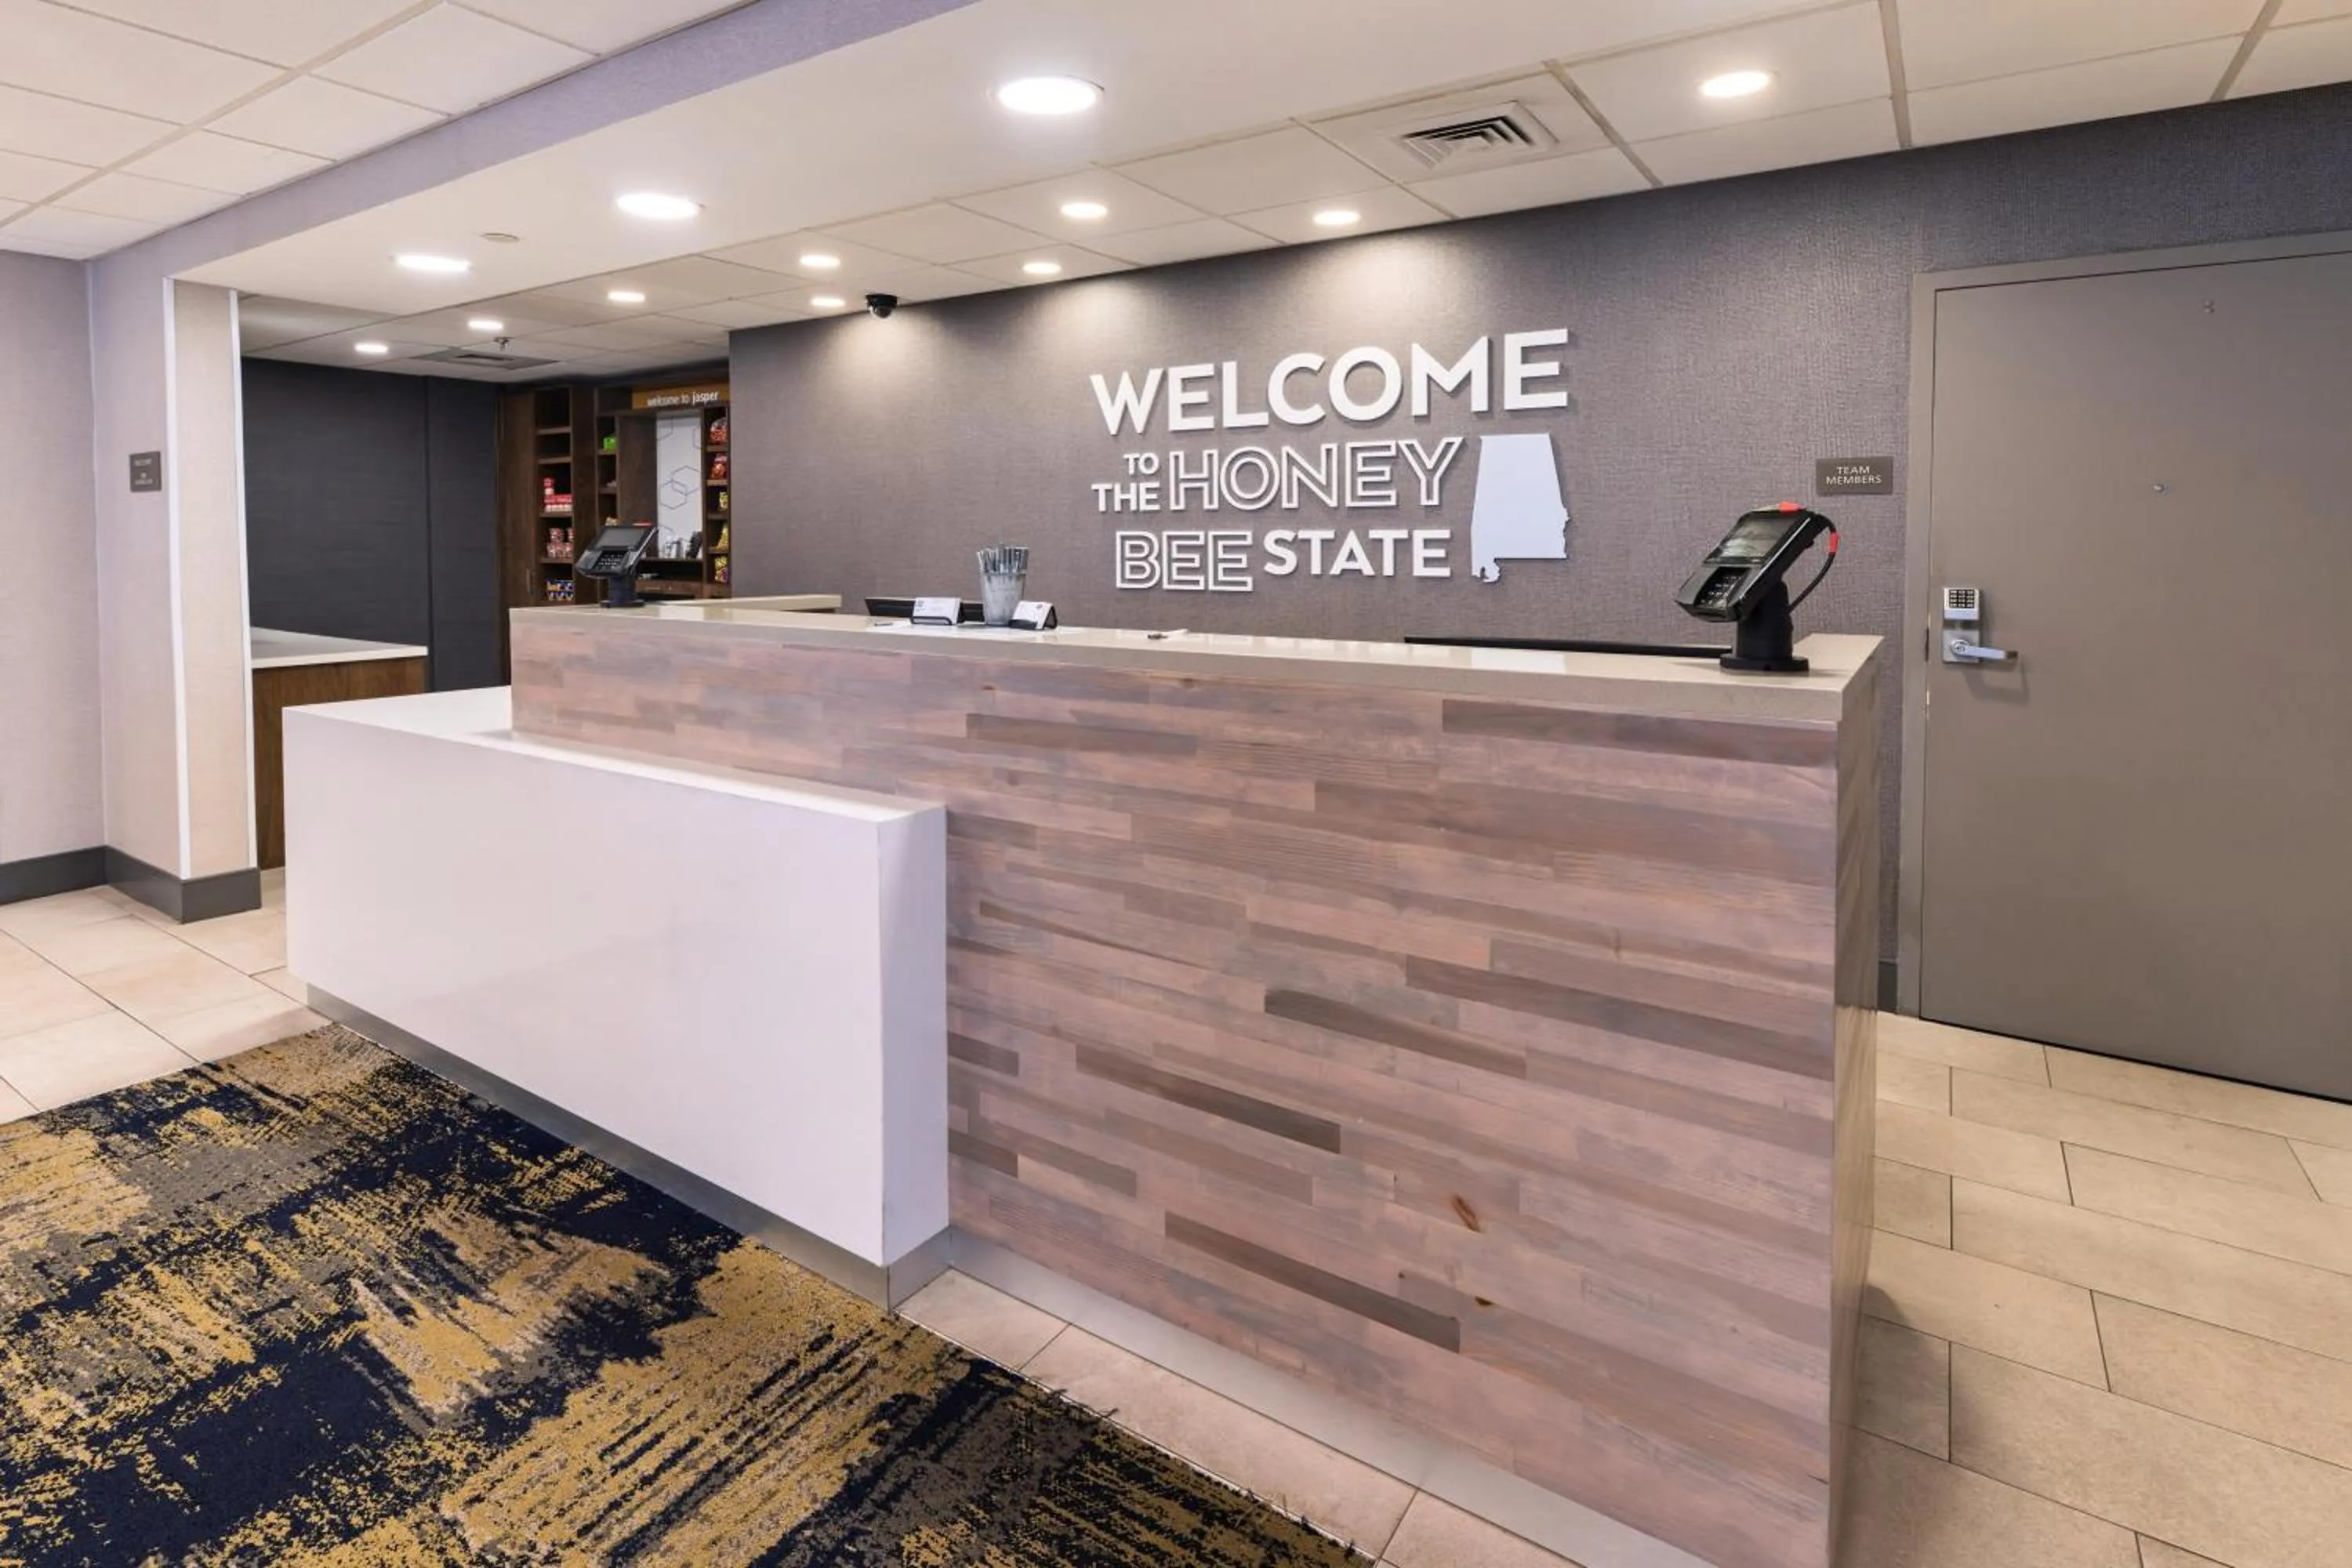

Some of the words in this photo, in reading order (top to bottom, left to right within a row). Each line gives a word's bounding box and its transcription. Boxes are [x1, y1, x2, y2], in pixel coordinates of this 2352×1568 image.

[1090, 328, 1568, 435] WELCOME
[648, 394, 680, 407] welcome
[681, 393, 690, 404] to
[692, 390, 718, 405] jasper
[1091, 481, 1160, 512] THE
[1169, 437, 1464, 511] HONEY
[1123, 452, 1160, 475] TO
[1836, 465, 1871, 475] TEAM
[1825, 474, 1882, 485] MEMBERS
[1116, 530, 1254, 592] BEE
[1263, 529, 1451, 578] STATE
